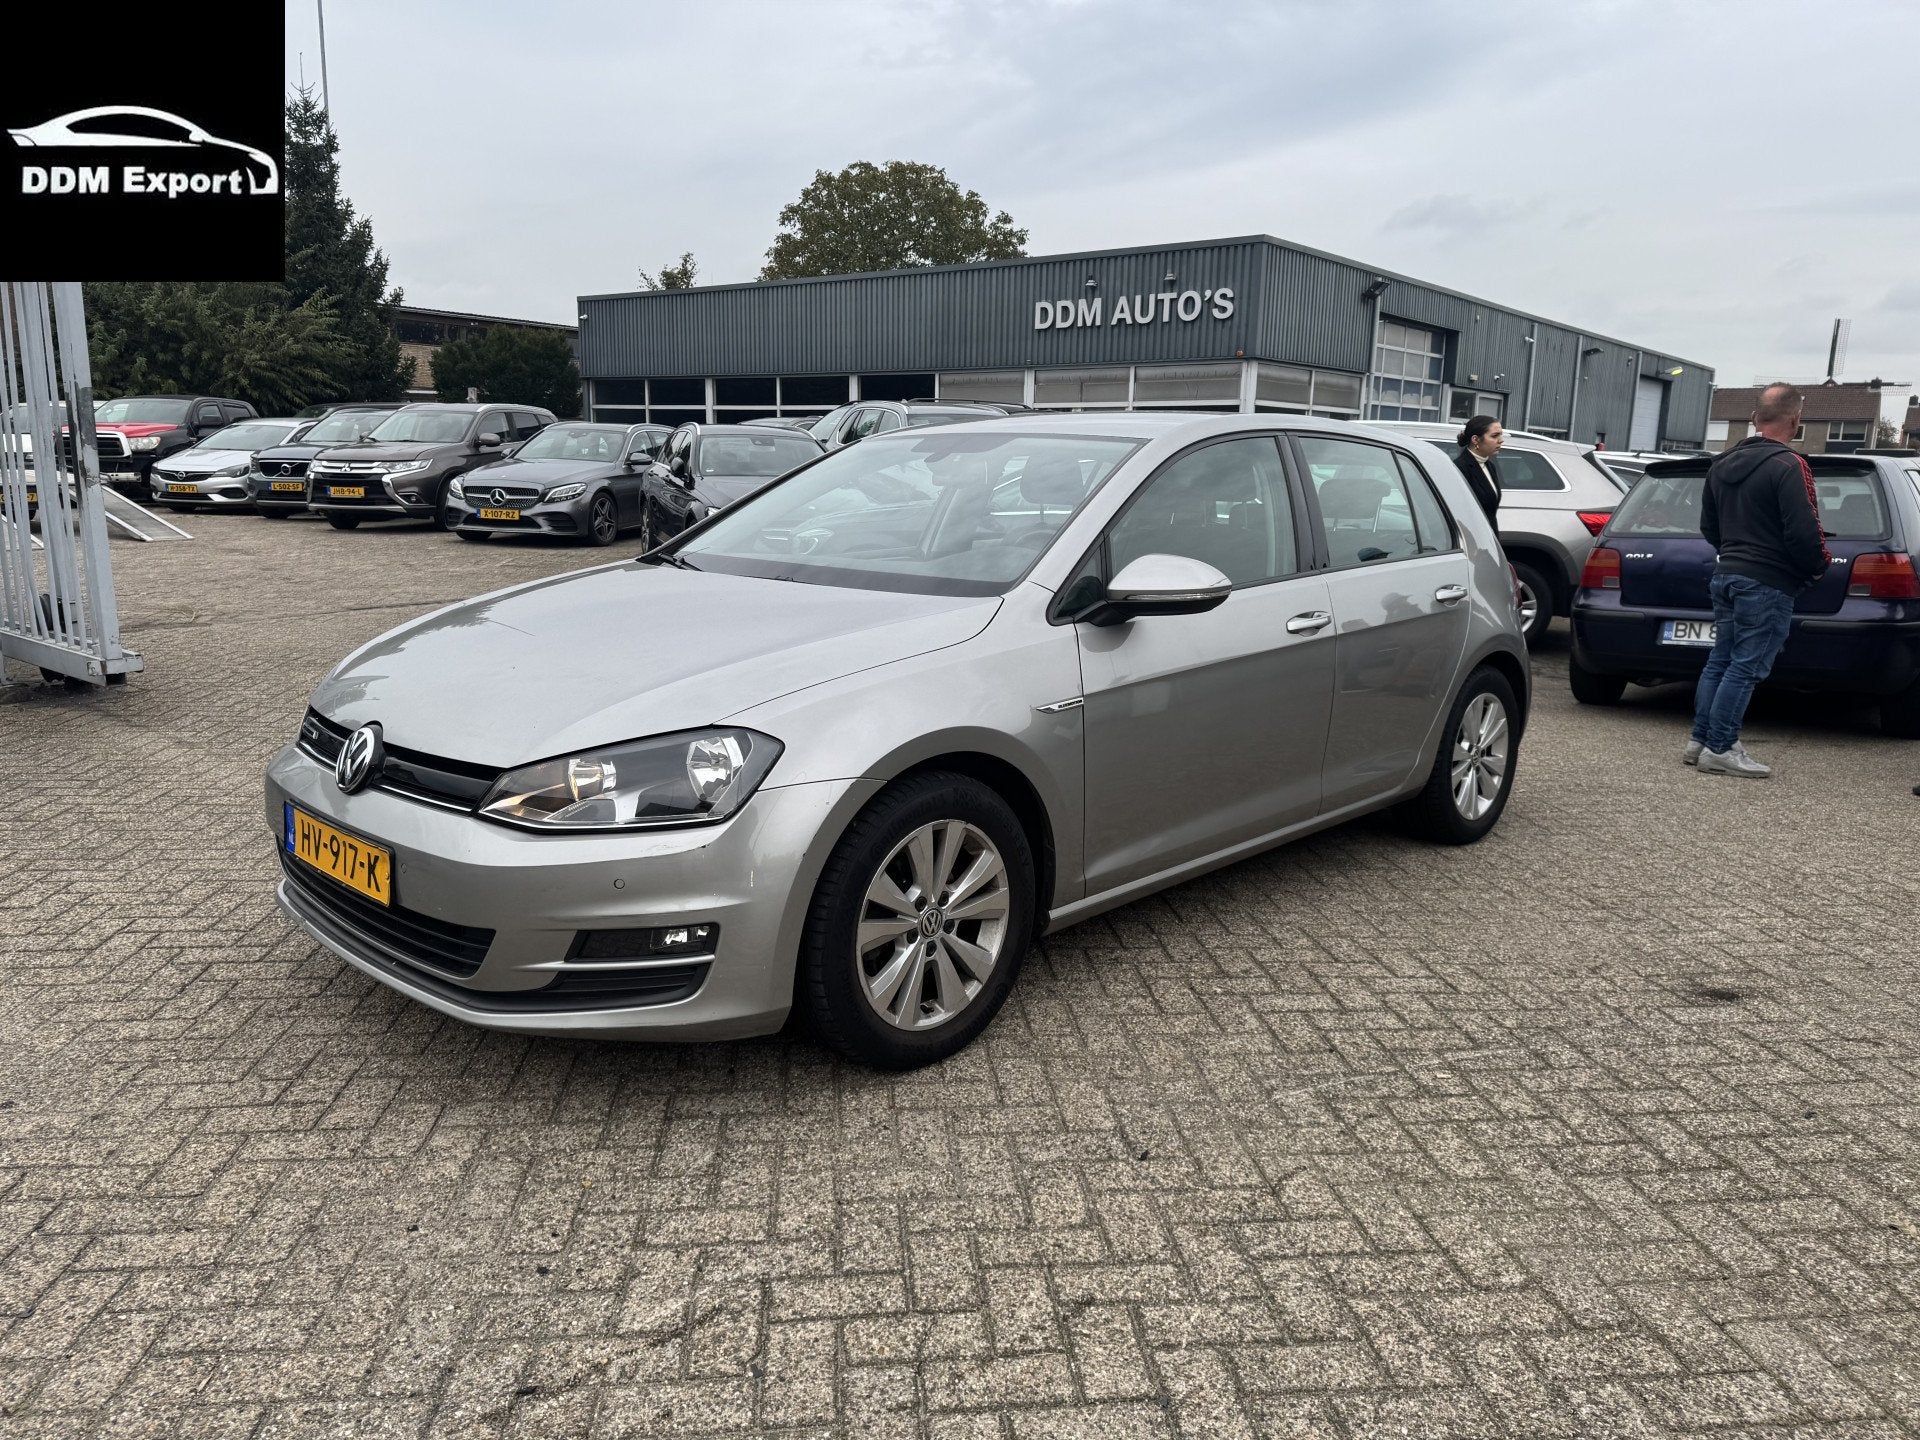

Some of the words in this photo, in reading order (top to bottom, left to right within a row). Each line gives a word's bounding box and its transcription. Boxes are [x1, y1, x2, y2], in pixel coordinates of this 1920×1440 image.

[1034, 297, 1102, 330] DDM
[1110, 287, 1235, 326] AUTO'S
[483, 510, 516, 519] X-107-RZ
[1673, 622, 1702, 639] BN
[301, 818, 381, 893] HV-917-K
